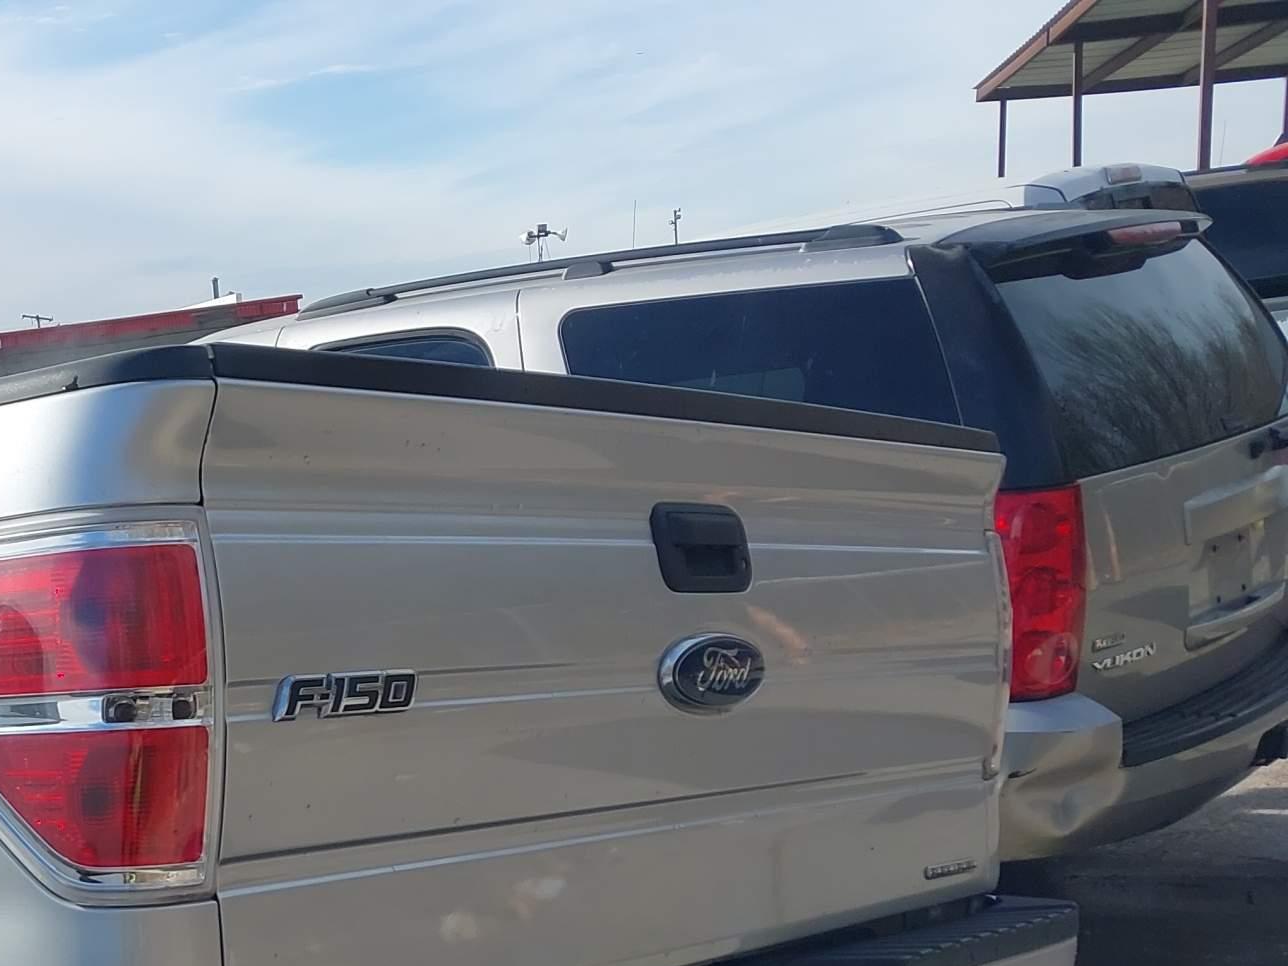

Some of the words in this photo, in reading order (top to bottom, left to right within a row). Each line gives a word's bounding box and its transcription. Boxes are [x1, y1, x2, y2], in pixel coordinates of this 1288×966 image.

[696, 646, 751, 691] Ford
[1091, 639, 1156, 671] YUKON
[272, 669, 417, 722] F-150
